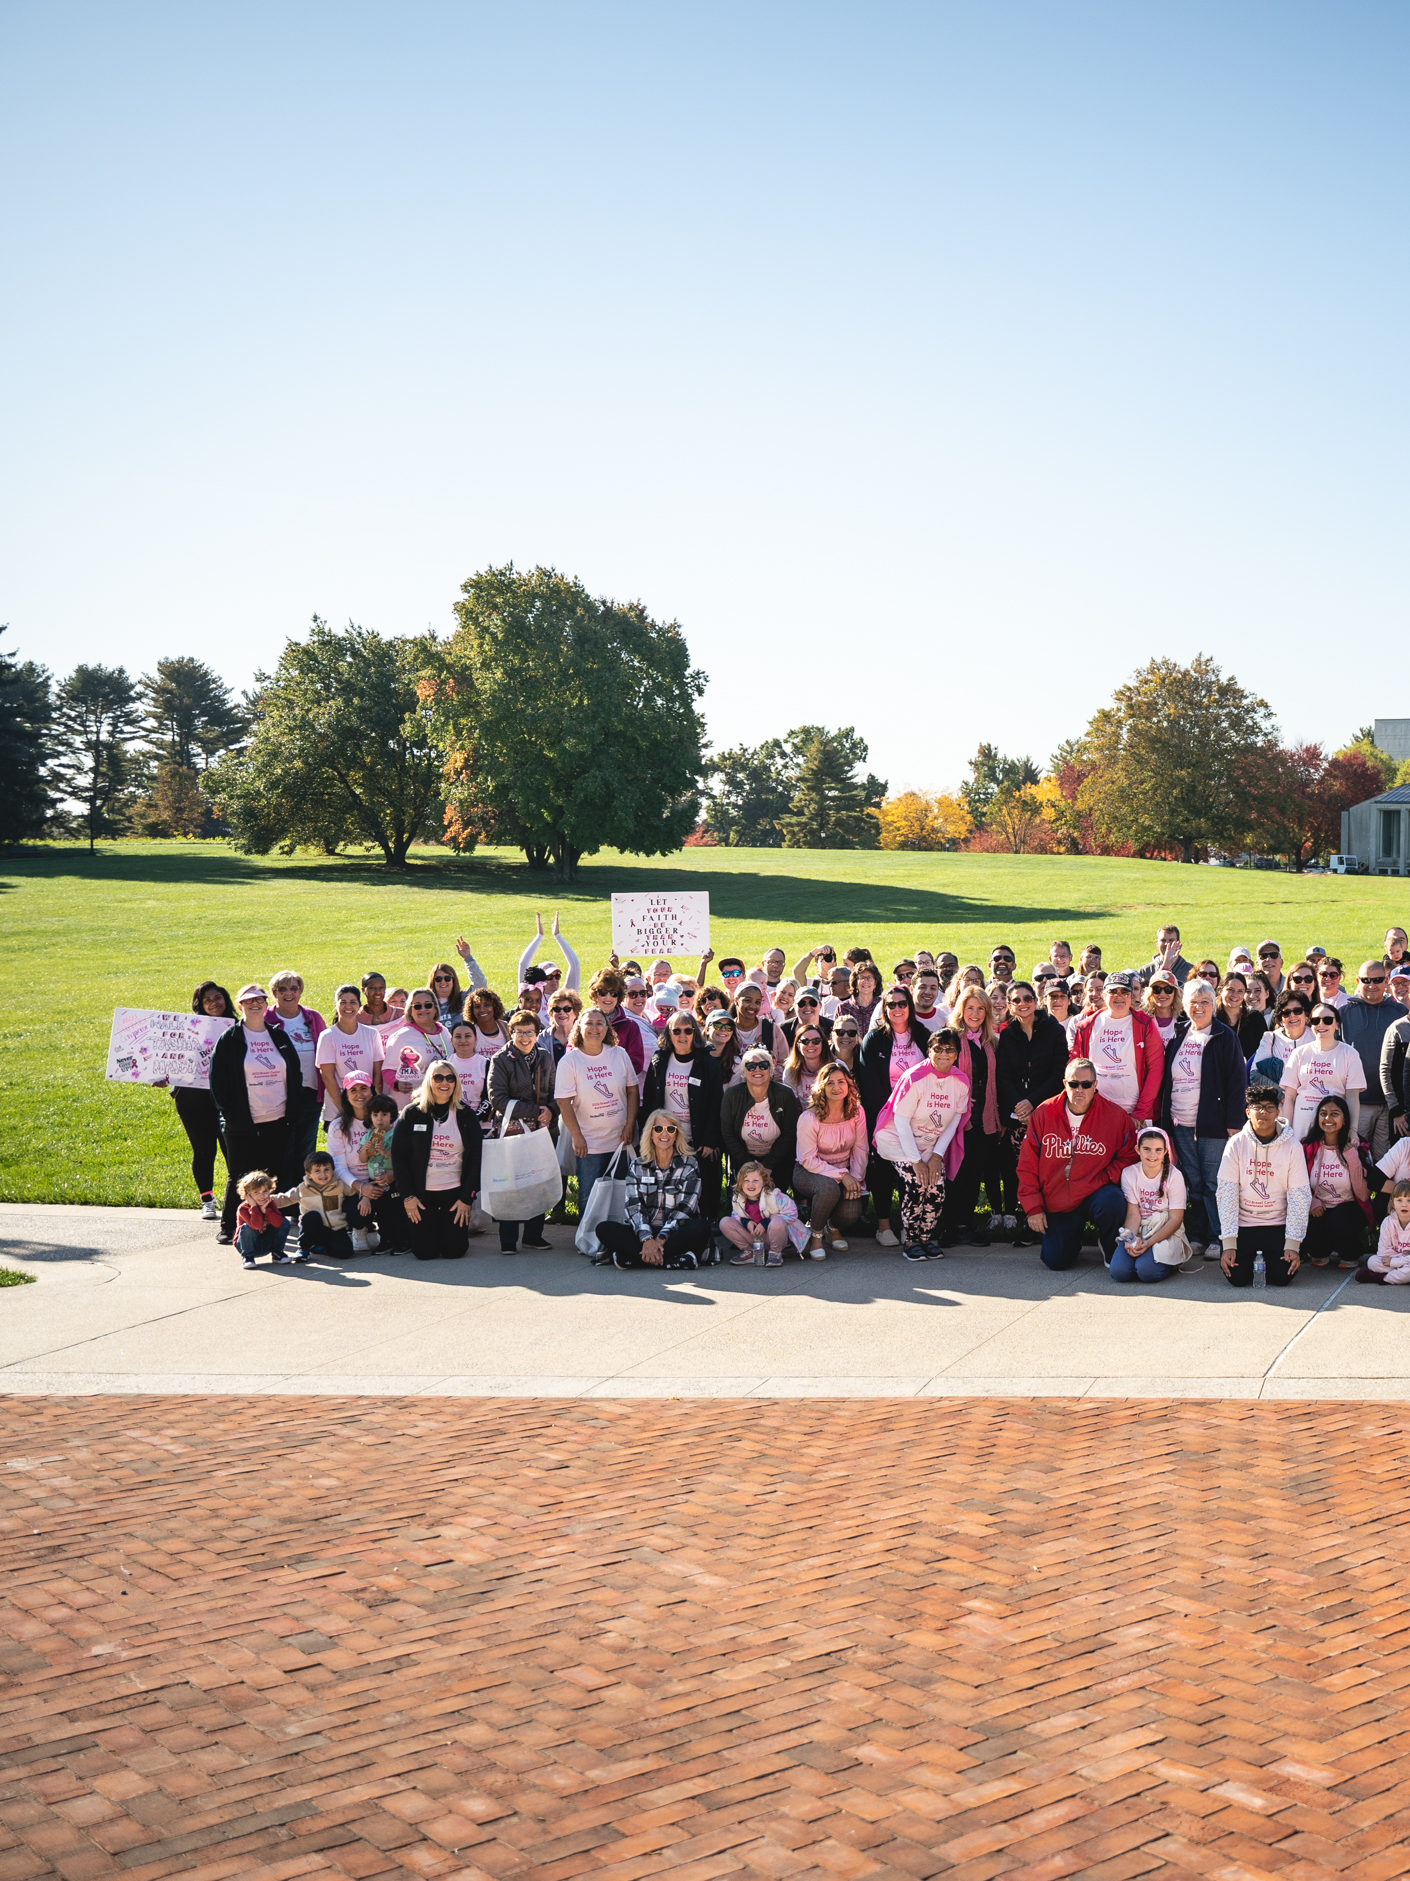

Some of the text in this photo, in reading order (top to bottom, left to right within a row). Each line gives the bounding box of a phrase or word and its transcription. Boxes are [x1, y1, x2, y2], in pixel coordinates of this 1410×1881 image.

[637, 927, 678, 935] BIGGER
[150, 1020, 186, 1031] WALK
[162, 1031, 185, 1039] FOR
[1183, 1042, 1201, 1050] Hope
[116, 1055, 133, 1064] Never
[587, 1065, 607, 1073] Hope
[594, 1071, 613, 1079] Here
[668, 1072, 689, 1080] Hope
[931, 1092, 949, 1100] Hope
[934, 1100, 951, 1108] Here
[432, 1134, 450, 1142] ope
[1249, 1159, 1272, 1168] Hope
[1323, 1170, 1343, 1178] Here
